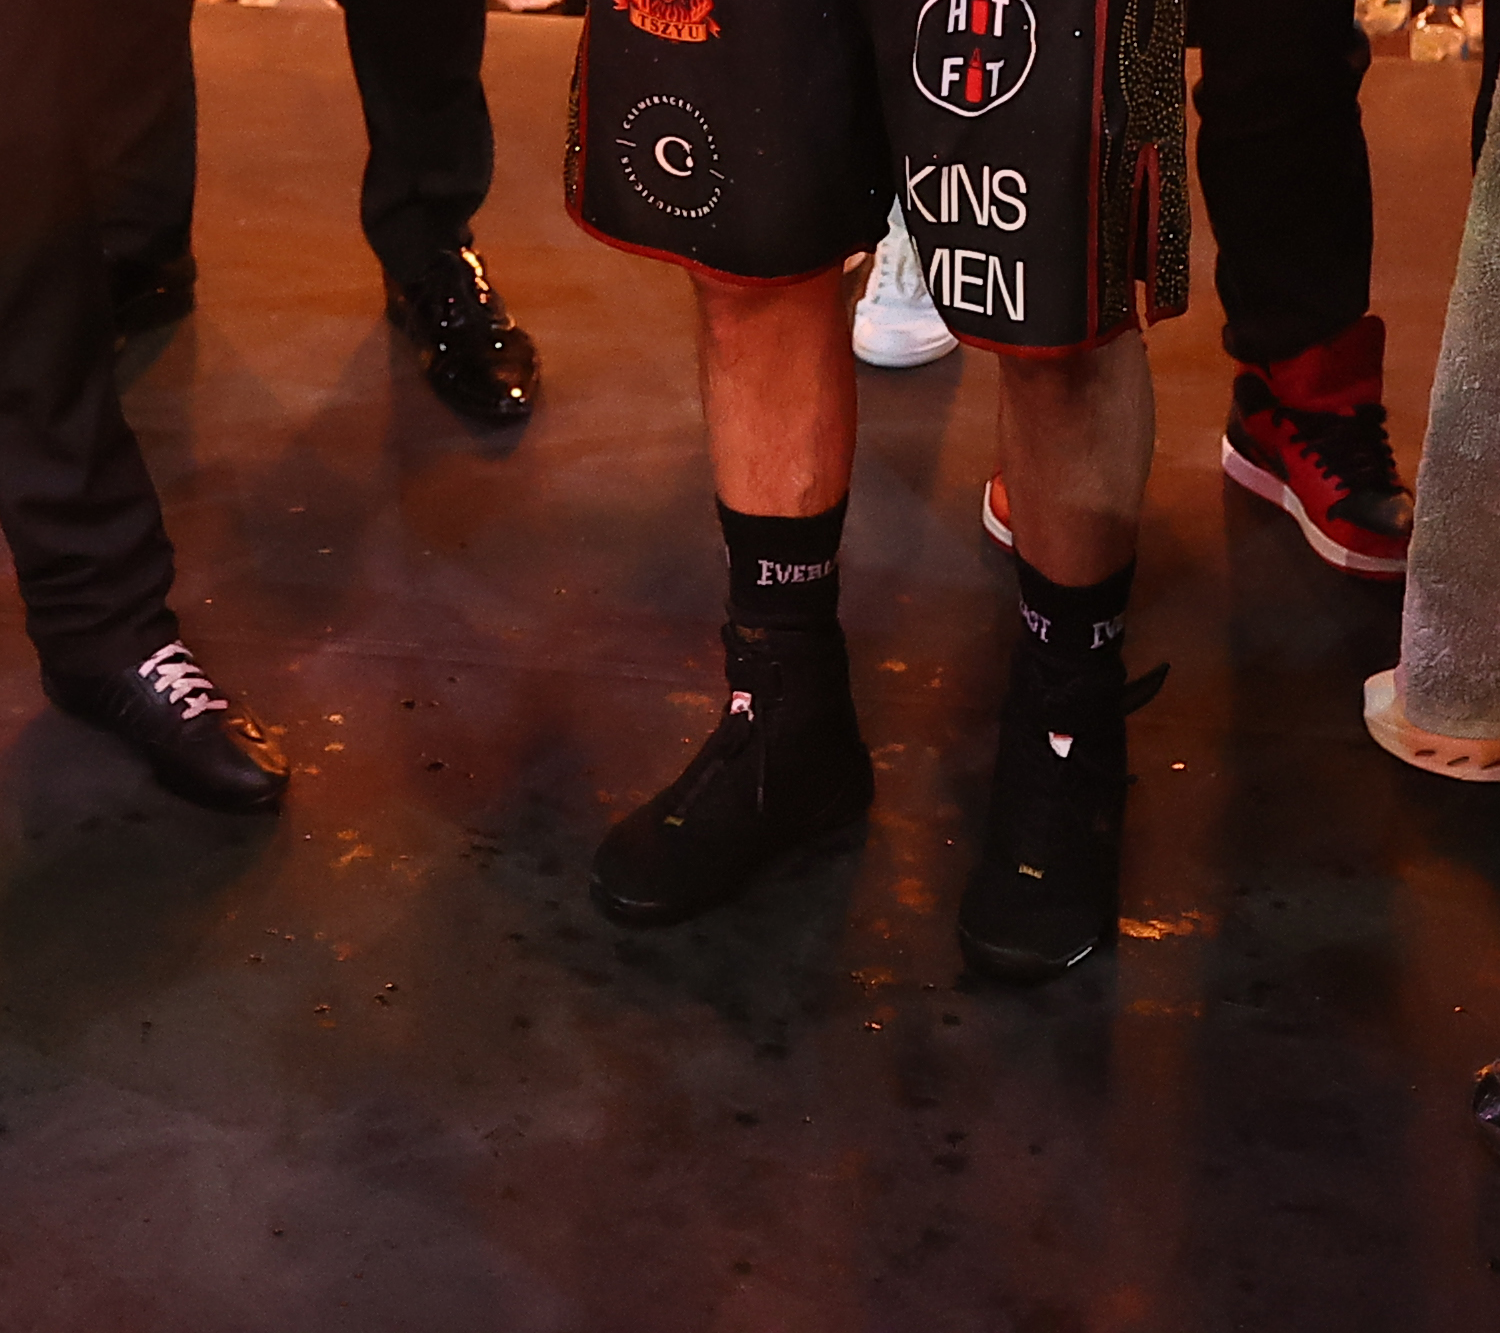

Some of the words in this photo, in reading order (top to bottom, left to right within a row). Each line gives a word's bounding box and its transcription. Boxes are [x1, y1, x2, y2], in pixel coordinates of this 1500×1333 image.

[637, 12, 701, 40] TSZYU
[905, 155, 1028, 232] KINS
[756, 559, 834, 587] EVER
